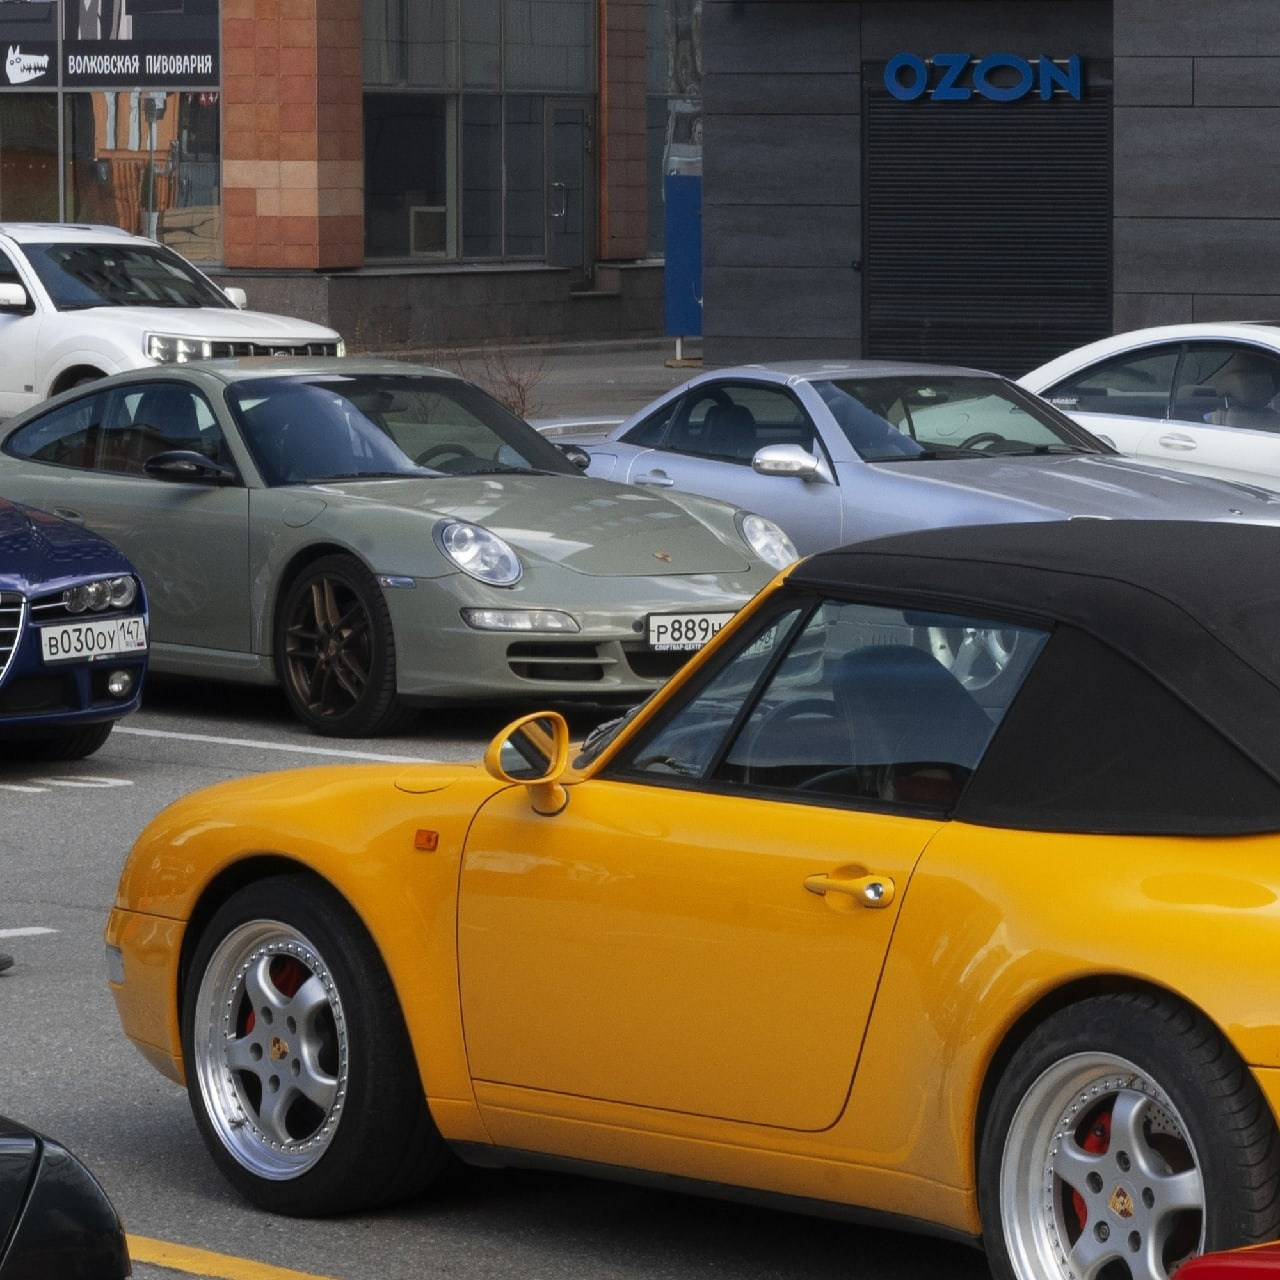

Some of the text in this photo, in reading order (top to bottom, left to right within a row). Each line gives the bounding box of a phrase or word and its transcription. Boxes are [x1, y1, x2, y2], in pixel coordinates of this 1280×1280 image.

[68, 54, 212, 75] ВОЛКОВСКАЯ ПИВОВАРНЯ
[884, 52, 1081, 101] OZON
[119, 620, 140, 641] 147
